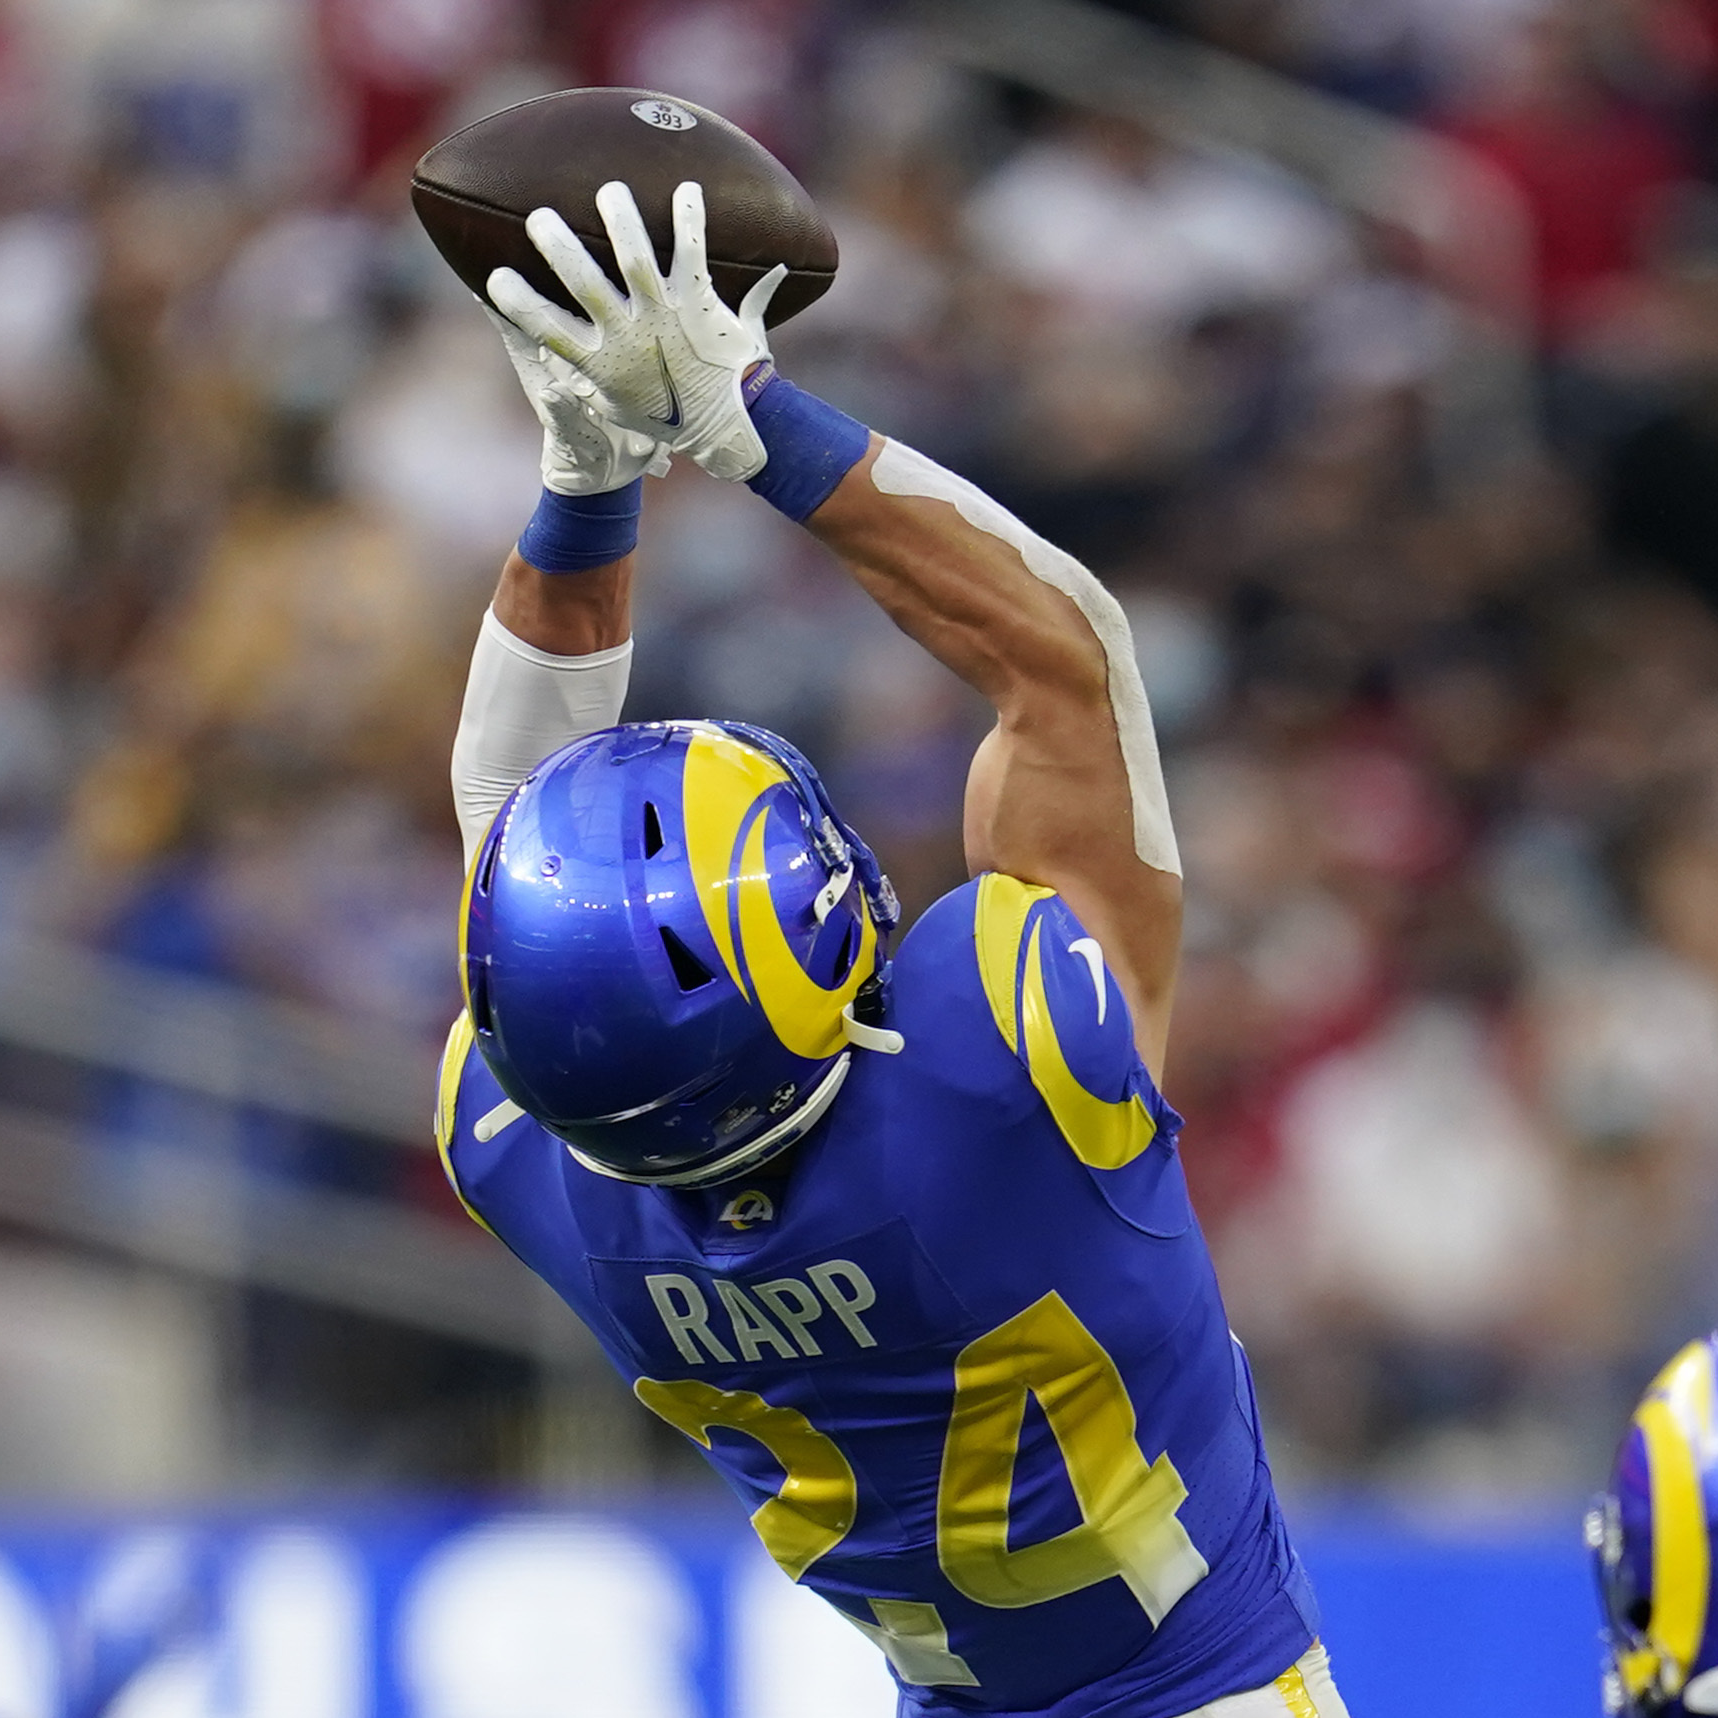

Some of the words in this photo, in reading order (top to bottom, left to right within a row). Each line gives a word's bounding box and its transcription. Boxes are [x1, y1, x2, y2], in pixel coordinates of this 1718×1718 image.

[651, 110, 683, 129] 393
[644, 1259, 878, 1364] RAPP
[634, 1290, 1209, 1687] 24
